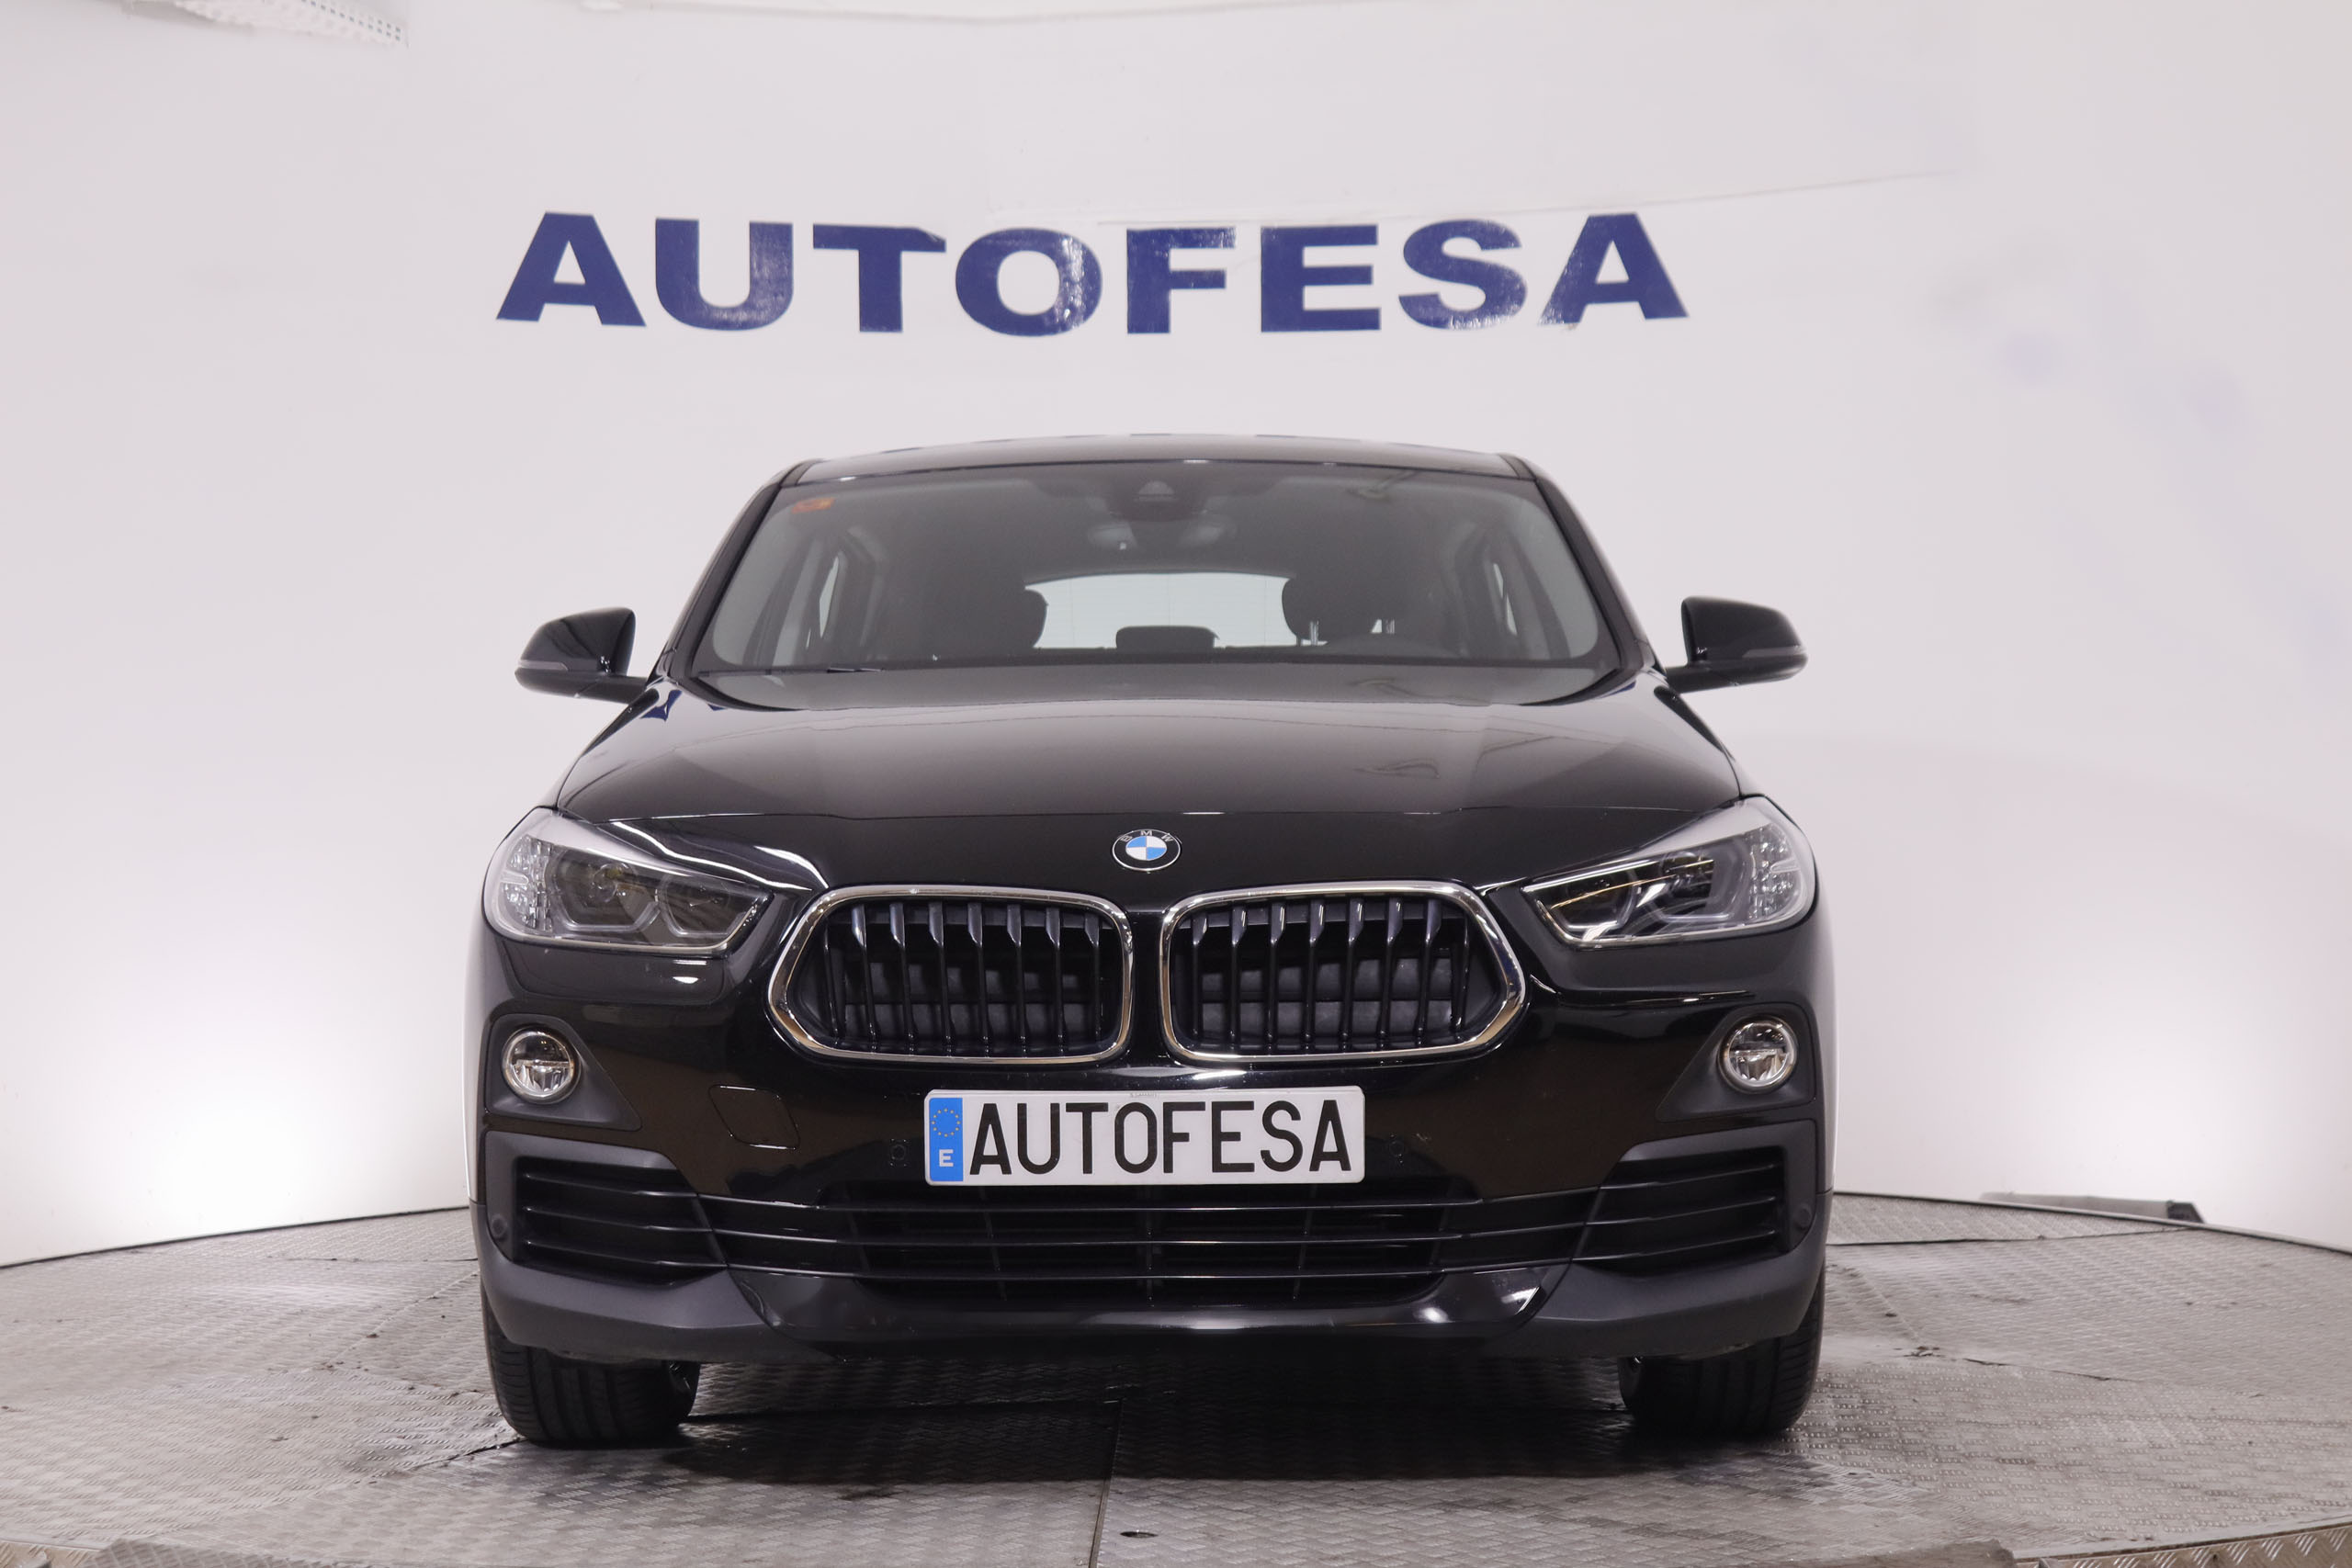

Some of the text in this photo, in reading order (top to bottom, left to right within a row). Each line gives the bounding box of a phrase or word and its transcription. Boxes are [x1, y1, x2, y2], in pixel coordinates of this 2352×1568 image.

[496, 212, 1688, 337] AUTOFESA
[1120, 830, 1174, 842] BMW
[939, 1149, 954, 1167] E
[969, 1100, 1351, 1175] AUTOFESA
